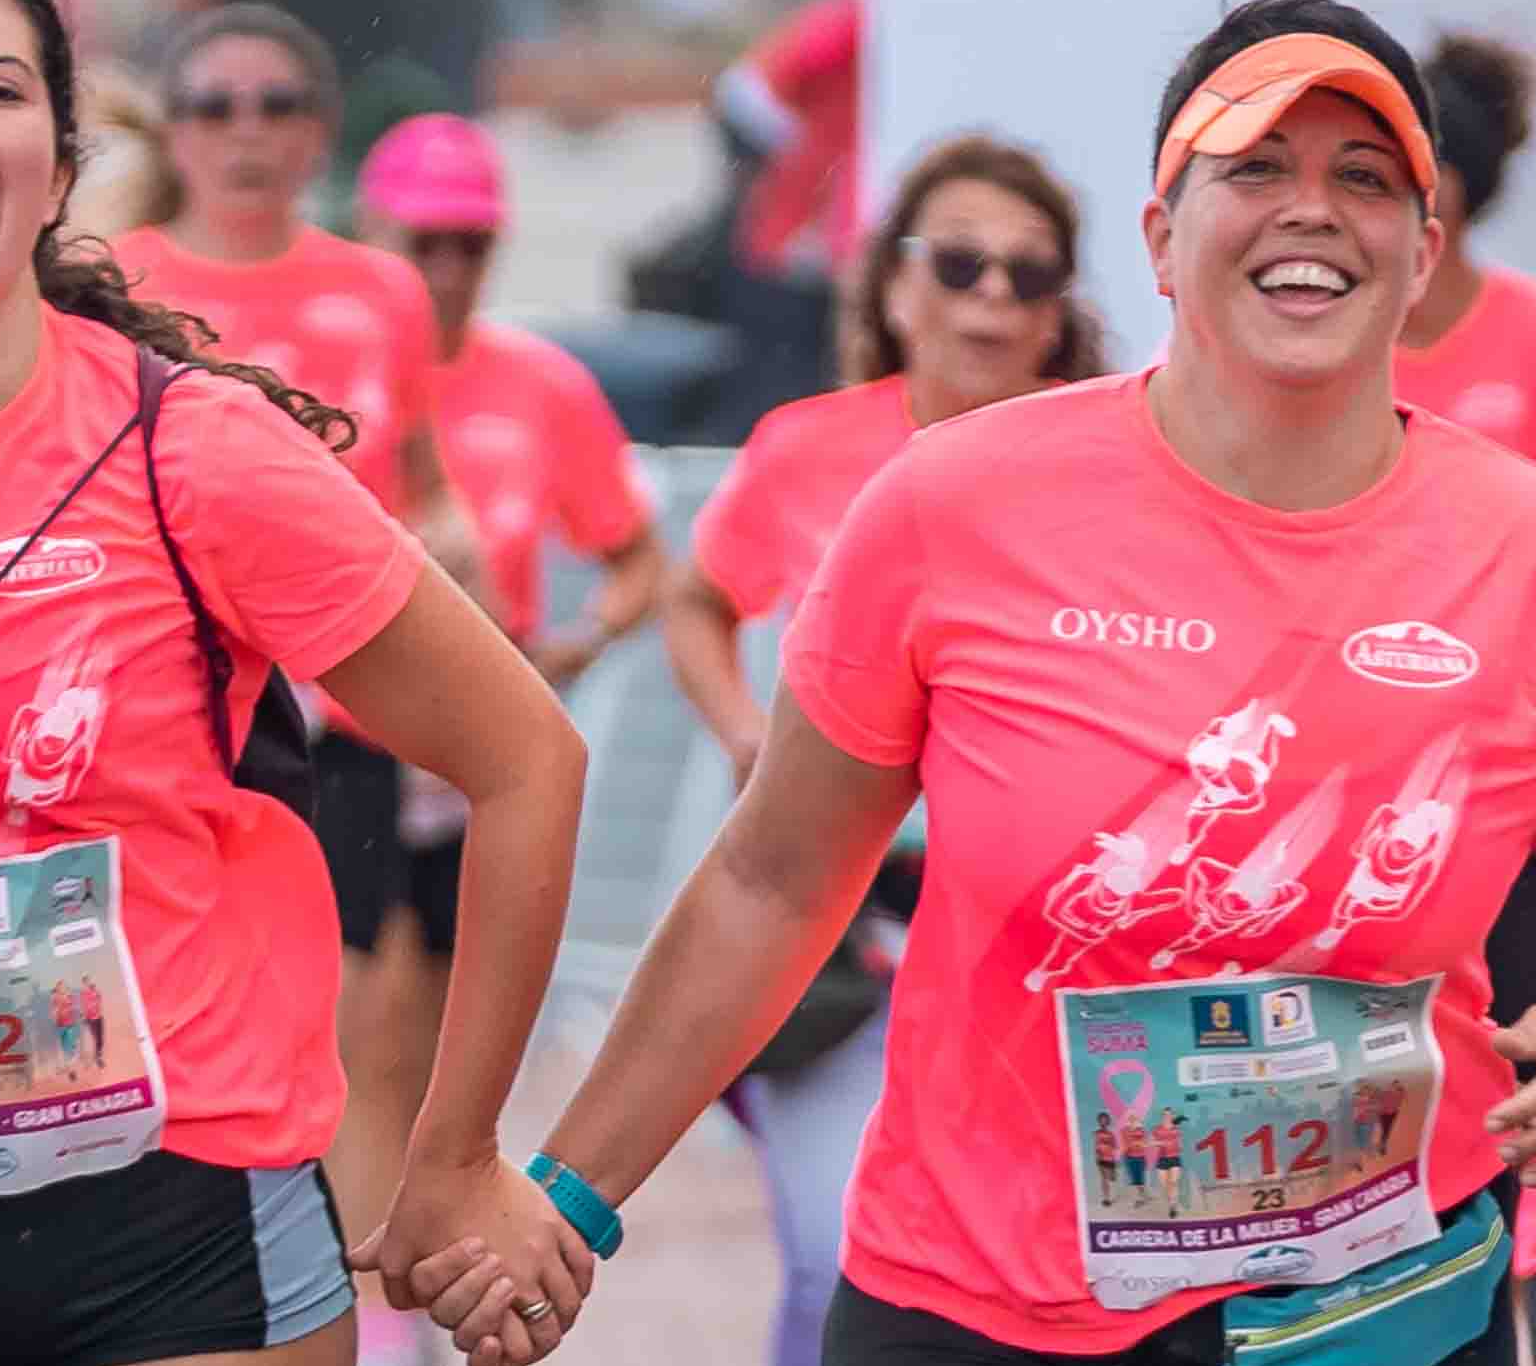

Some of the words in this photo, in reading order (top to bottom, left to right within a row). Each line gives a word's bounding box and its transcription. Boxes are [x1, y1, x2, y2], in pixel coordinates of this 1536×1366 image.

[1050, 606, 1217, 653] OYSHO
[12, 1105, 65, 1130] GRAN
[68, 1087, 145, 1120] CANARIA
[1194, 1119, 1331, 1180] 112
[1251, 1188, 1286, 1211] 23
[1095, 1228, 1177, 1249] CARRERA
[1181, 1227, 1207, 1249] DE
[1210, 1225, 1236, 1245] LA
[1237, 1217, 1301, 1242] MUJER
[1313, 1201, 1353, 1228] GRAN
